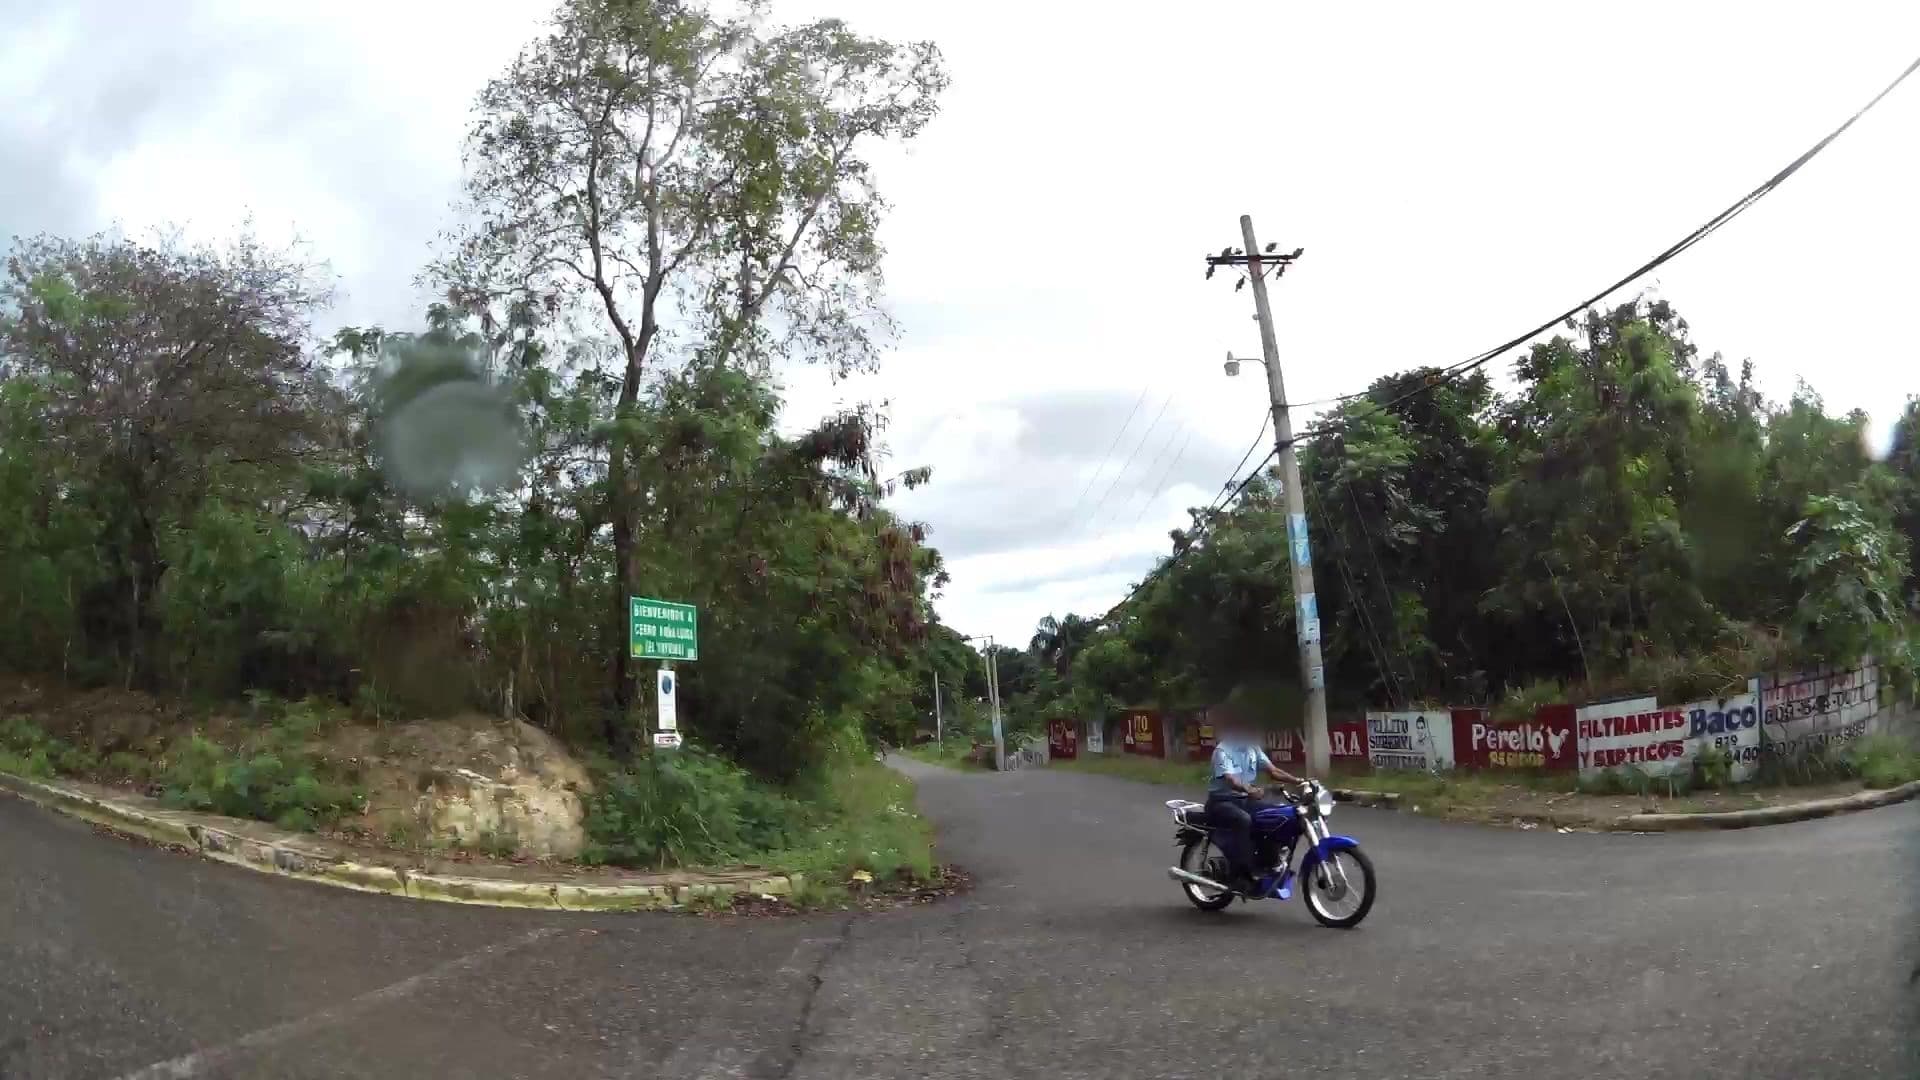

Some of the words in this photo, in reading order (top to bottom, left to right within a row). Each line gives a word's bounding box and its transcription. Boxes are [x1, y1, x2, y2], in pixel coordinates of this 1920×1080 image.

[688, 612, 693, 622] A
[1579, 710, 1685, 740] FILTRANTES
[1689, 705, 1757, 737] Baco
